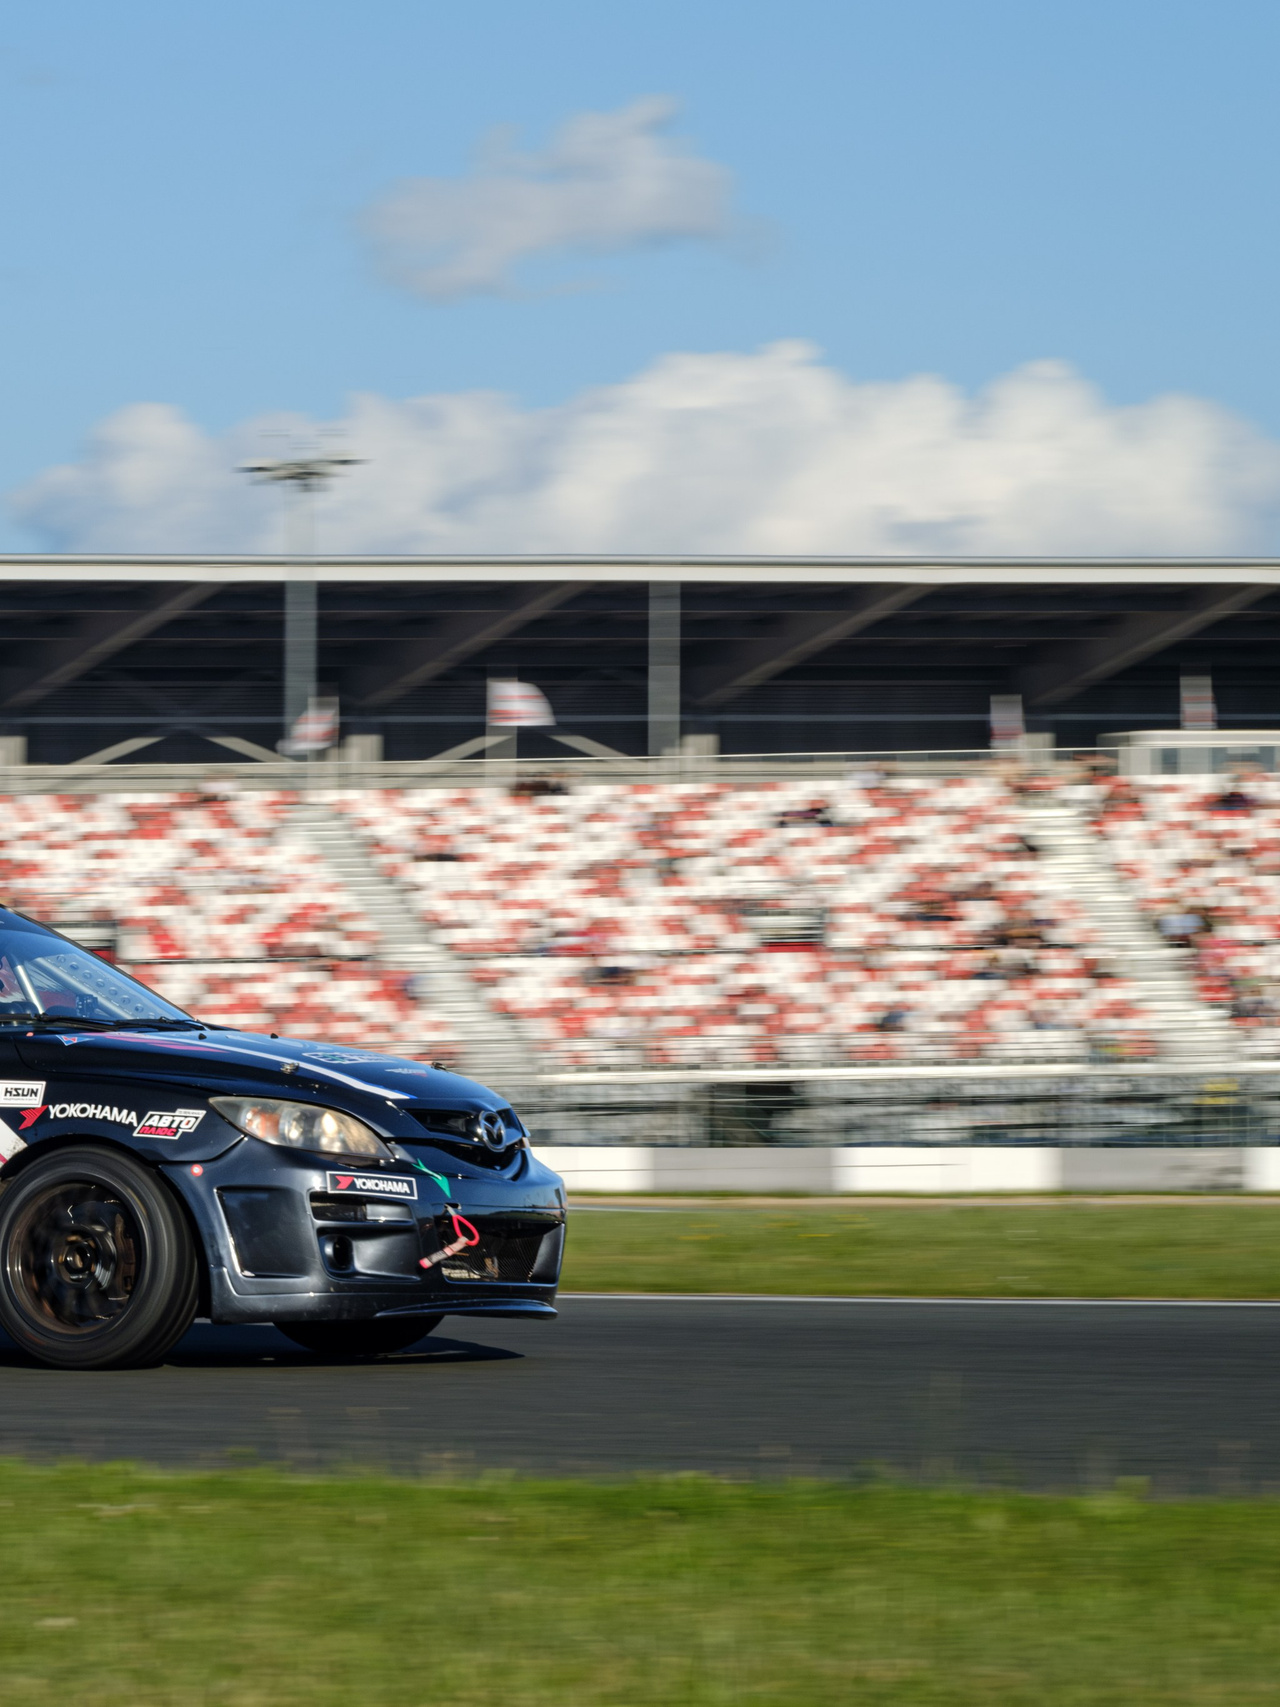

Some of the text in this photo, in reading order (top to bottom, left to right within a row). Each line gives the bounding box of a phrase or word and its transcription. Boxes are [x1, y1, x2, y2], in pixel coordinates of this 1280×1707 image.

[48, 1103, 138, 1127] YOKOHAMA
[144, 1115, 197, 1128] АВТО
[139, 1126, 177, 1136] ПЛЮС
[353, 1177, 411, 1194] YOKOHAMA
